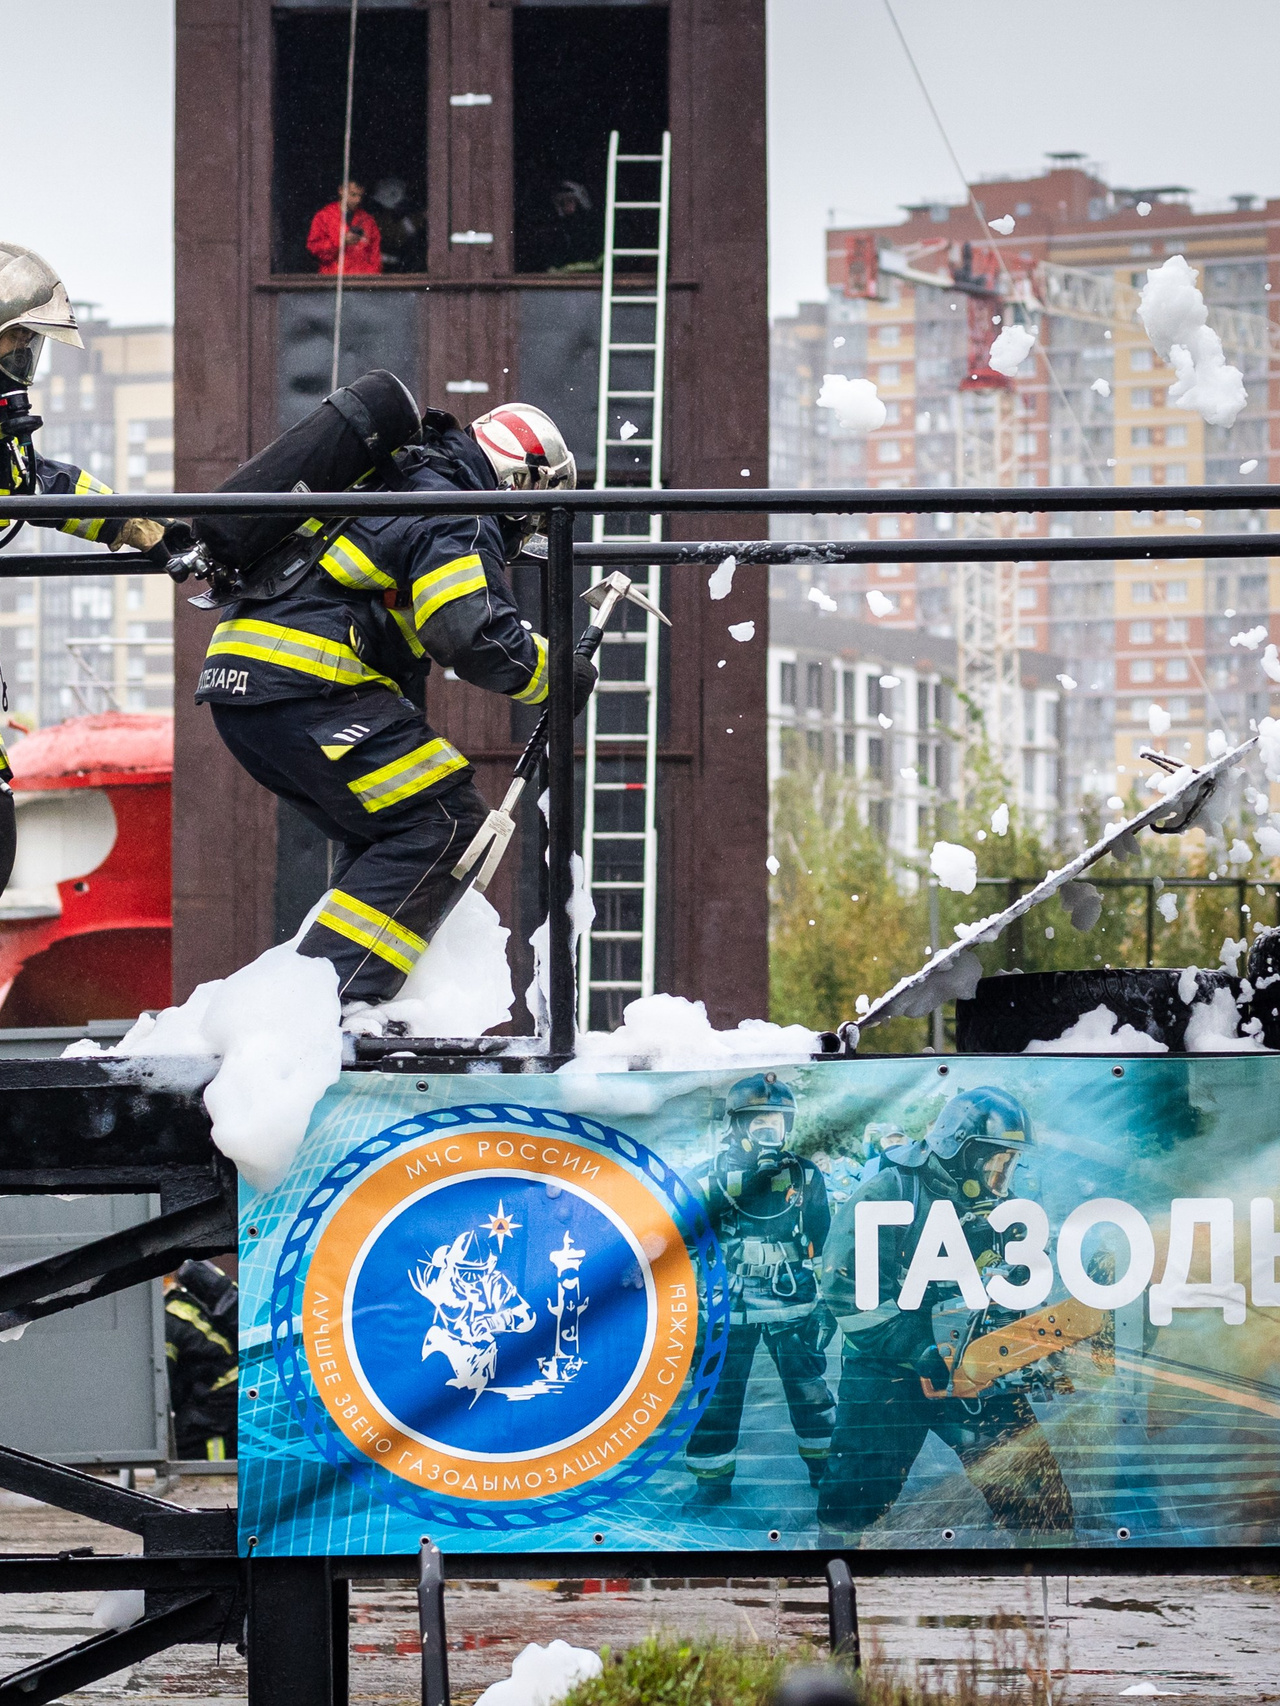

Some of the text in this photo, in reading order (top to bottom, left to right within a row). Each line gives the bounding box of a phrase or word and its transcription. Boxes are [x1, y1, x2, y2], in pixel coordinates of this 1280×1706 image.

[405, 1140, 601, 1180] МЧС РОССИИ
[854, 1197, 1280, 1326] ГАЗОД
[312, 1283, 688, 1492] ЛУЧШЕЕ ЗВЕНО ГАЗОДЫМОЗАЩИТНОЙ СЛУЖБЫ
